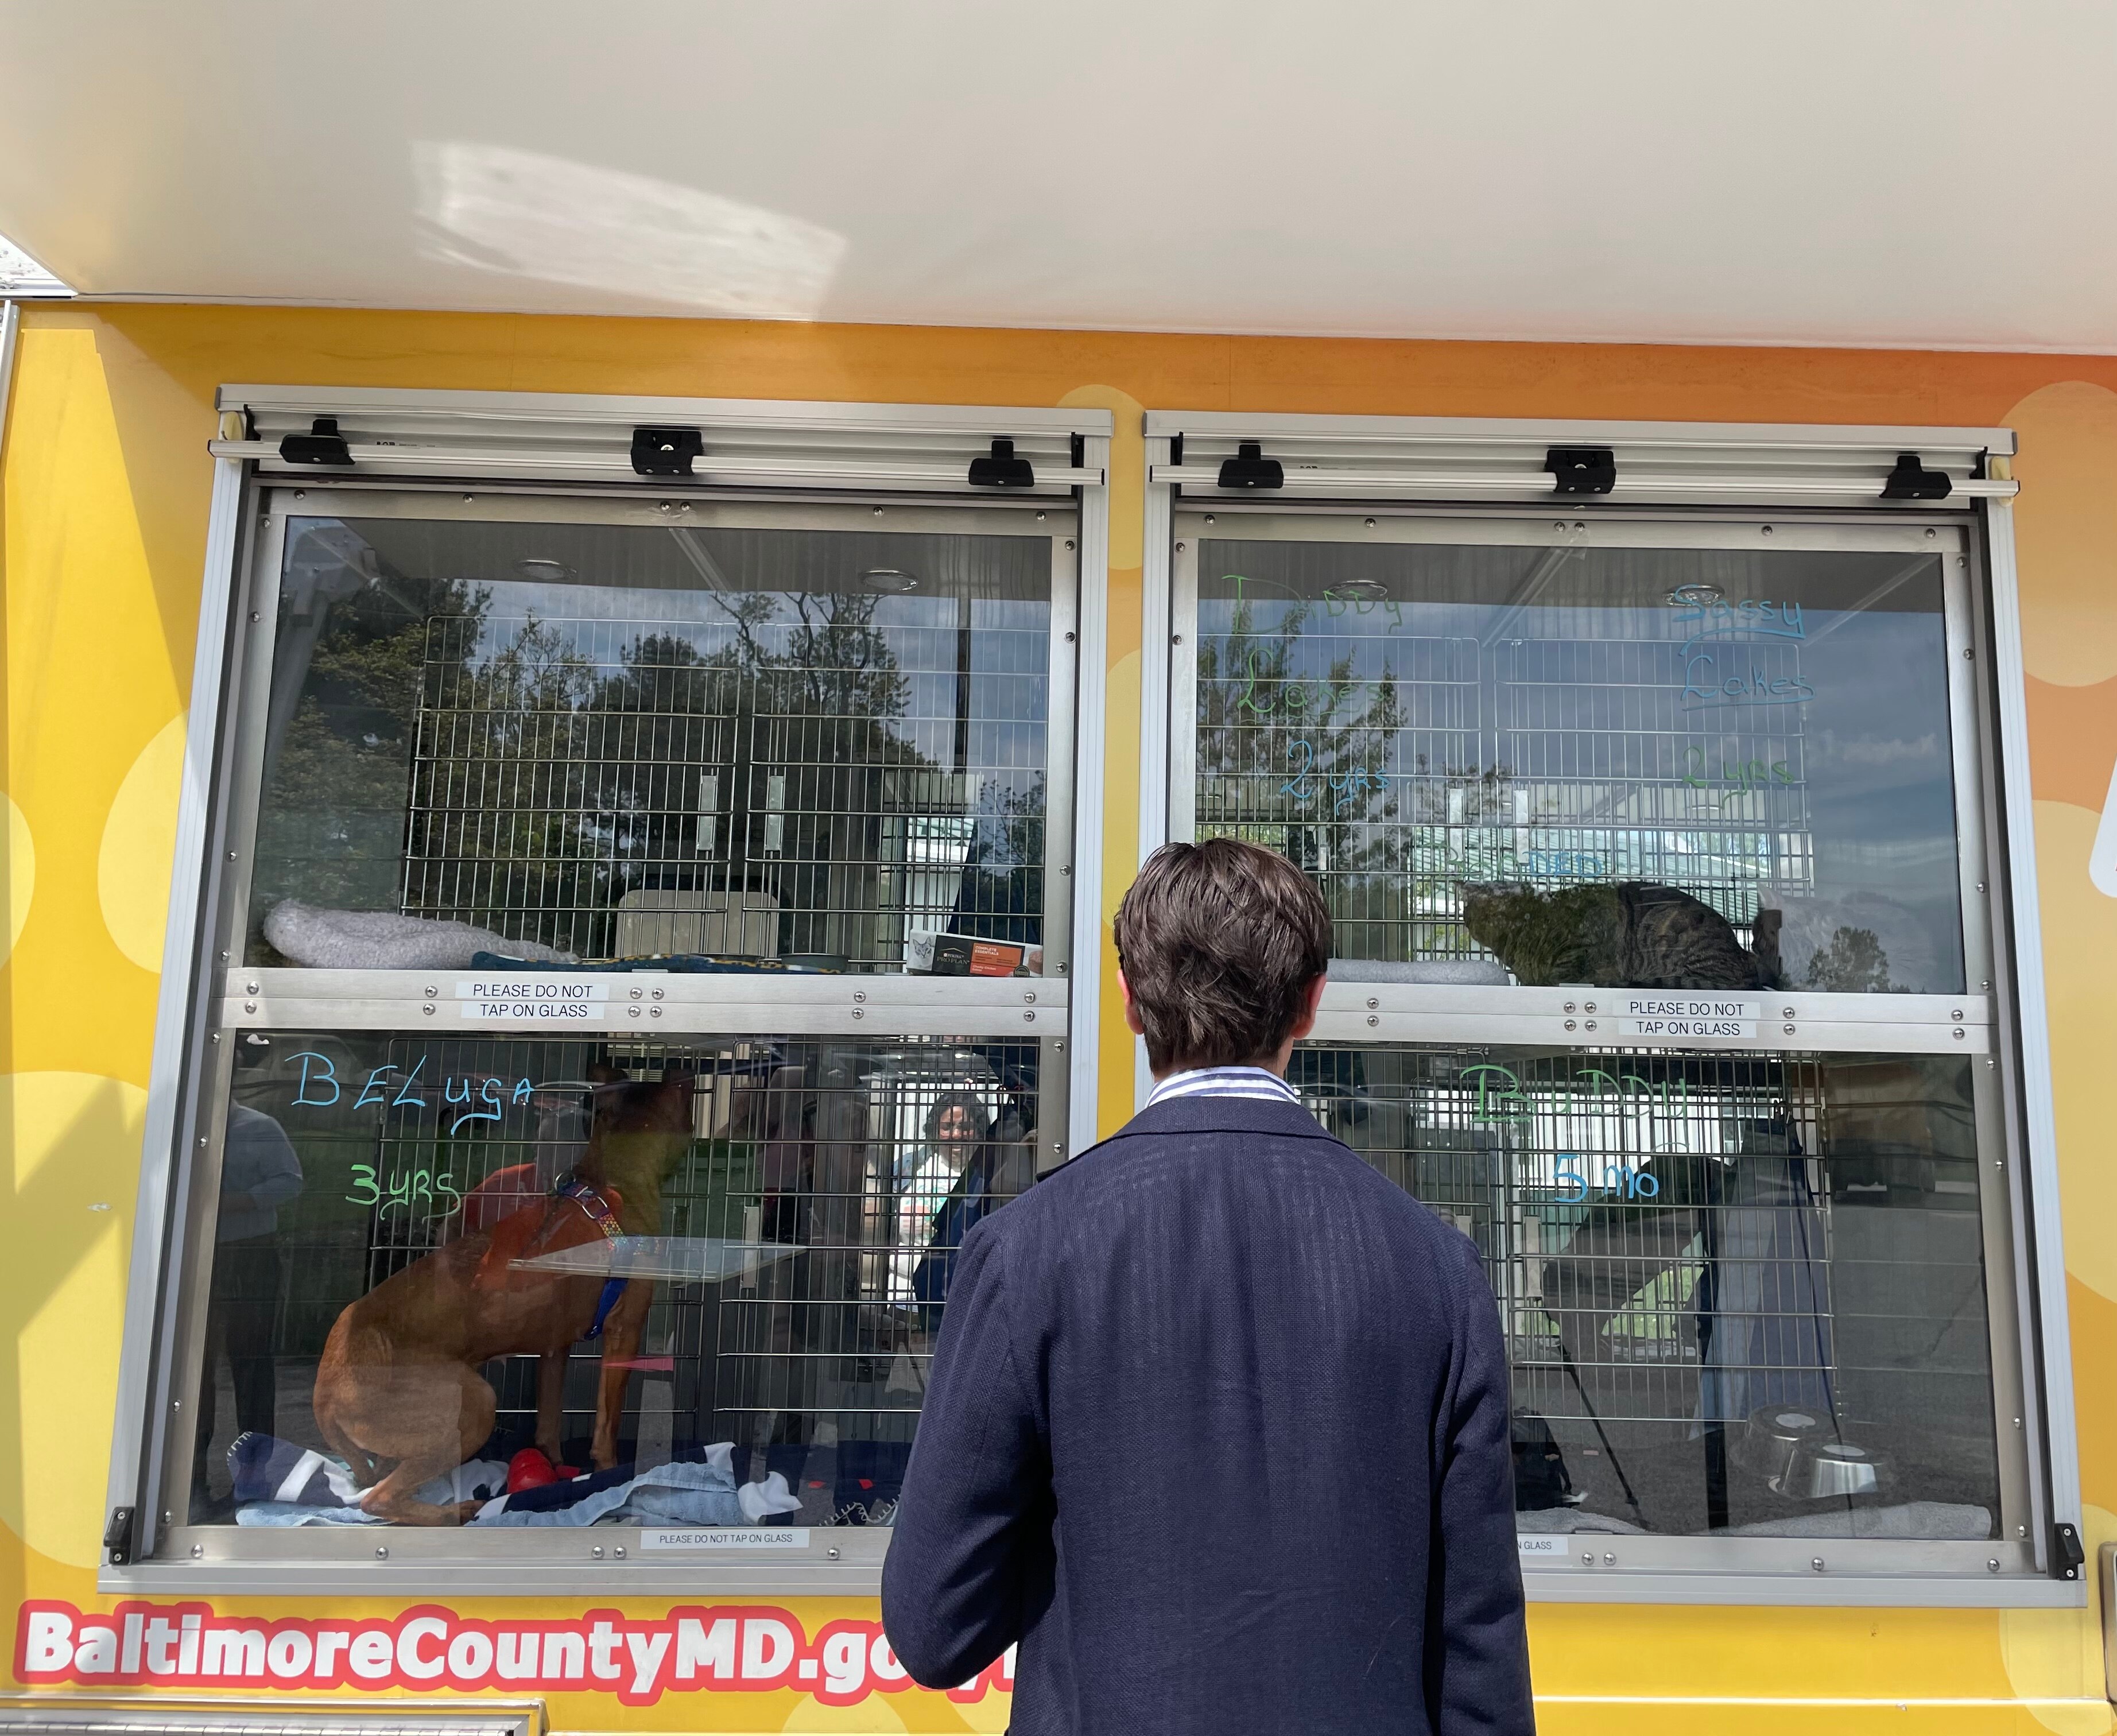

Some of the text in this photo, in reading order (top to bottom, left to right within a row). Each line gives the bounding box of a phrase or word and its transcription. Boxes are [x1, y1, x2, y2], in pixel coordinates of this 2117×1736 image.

[1673, 583, 1806, 656] Sassy
[1280, 740, 1313, 799] 2
[1682, 746, 1710, 788] 2
[473, 983, 593, 998] PLEASE DO NOT
[480, 1003, 588, 1017] TAP ON GLASS
[1630, 1001, 1744, 1016] PLEASE DO NOT
[1636, 1021, 1740, 1036] TAP ON GLASS
[346, 1164, 381, 1206] 3
[1552, 1154, 1588, 1203] 5
[660, 1534, 793, 1544] PLEASE DO NOT TAP ON GLASS
[1524, 1541, 1552, 1549] GLASS
